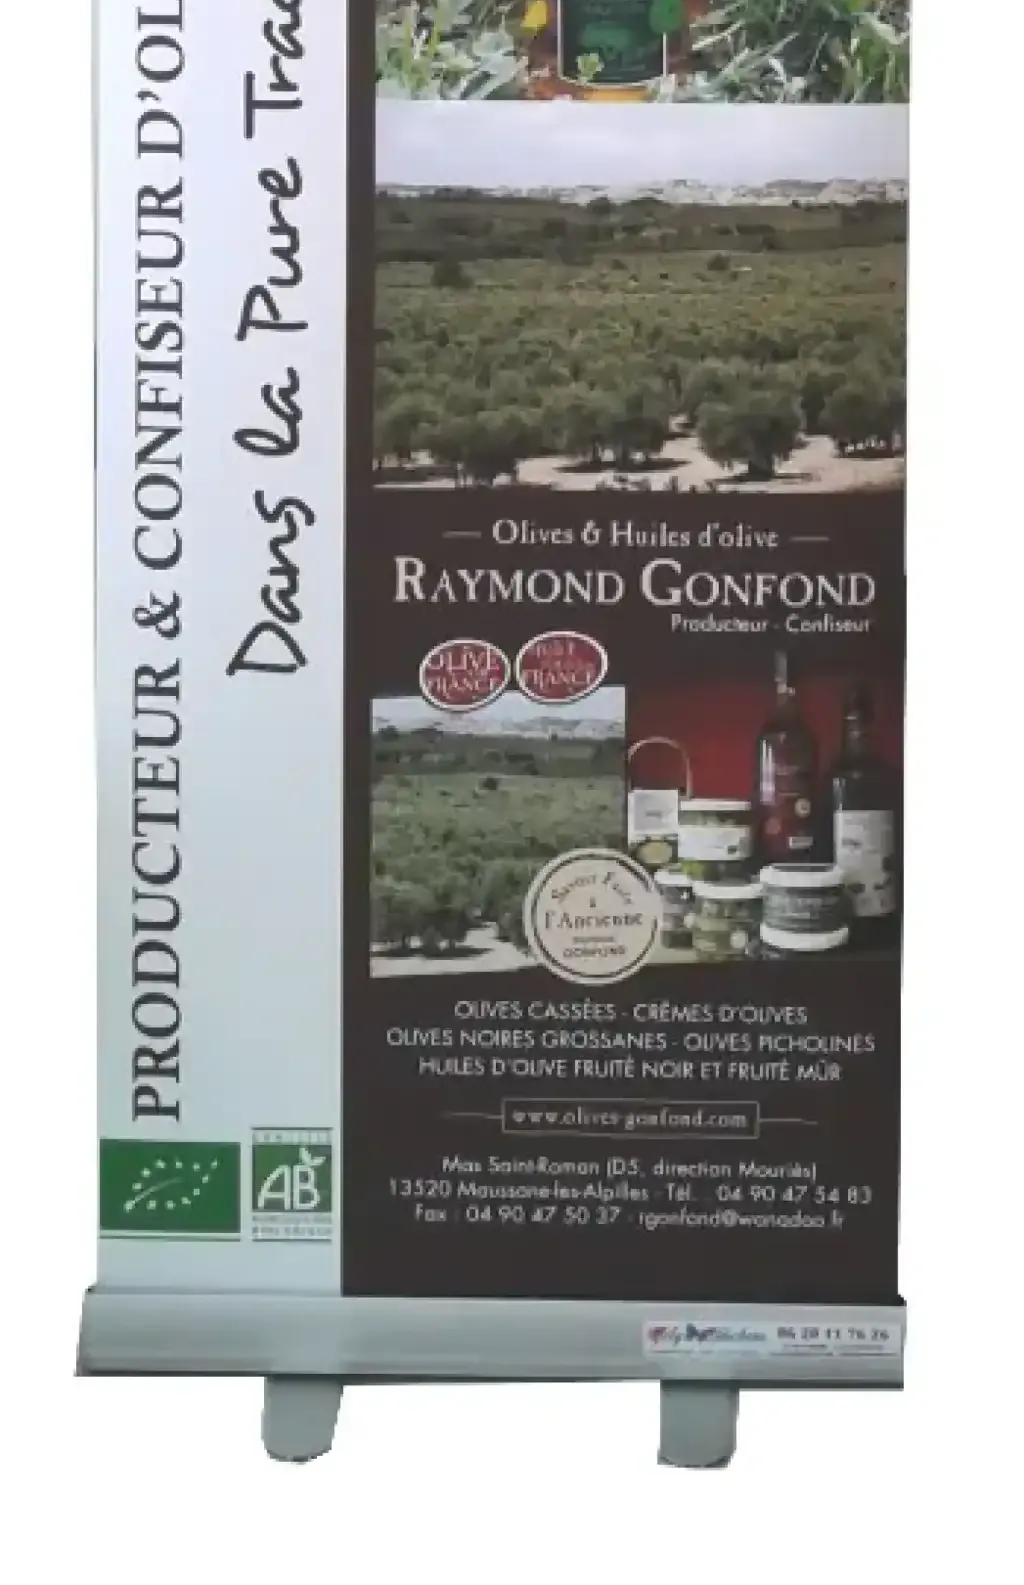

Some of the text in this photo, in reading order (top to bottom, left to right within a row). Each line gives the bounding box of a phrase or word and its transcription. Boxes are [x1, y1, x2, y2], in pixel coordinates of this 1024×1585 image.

[237, 158, 308, 342] Pure
[135, 181, 183, 570] CONFISEUR
[234, 367, 303, 456] la
[492, 519, 573, 544] Olives
[609, 520, 690, 547] Huiles
[698, 522, 779, 548] d'olive
[226, 490, 315, 676] Dans
[134, 592, 180, 638] &
[671, 614, 870, 633] Producteur Confiseur
[131, 660, 180, 1122] PRODUCTEUR
[454, 1000, 523, 1020] OLIVES
[527, 997, 617, 1021] CASSÉES
[718, 1005, 808, 1025] D'OLIVES
[386, 1027, 875, 1054] OLIVES NOIRES GROSSANES OLIVES PICHOLINES
[418, 1055, 841, 1082] HUILES D'OLIVE FRUITÉ NOIR ET FRUITÉ MÛR
[442, 1155, 482, 1173] Mas
[653, 1159, 733, 1177] direction
[257, 1164, 320, 1210] AB
[390, 1178, 451, 1198] 13520
[750, 1185, 776, 1202] 90
[782, 1185, 808, 1202] 47
[813, 1186, 840, 1204] 54
[415, 1203, 447, 1222] Fax
[465, 1204, 492, 1222] 04
[499, 1205, 526, 1223] 90
[531, 1206, 557, 1224] 47
[563, 1206, 591, 1225] 50
